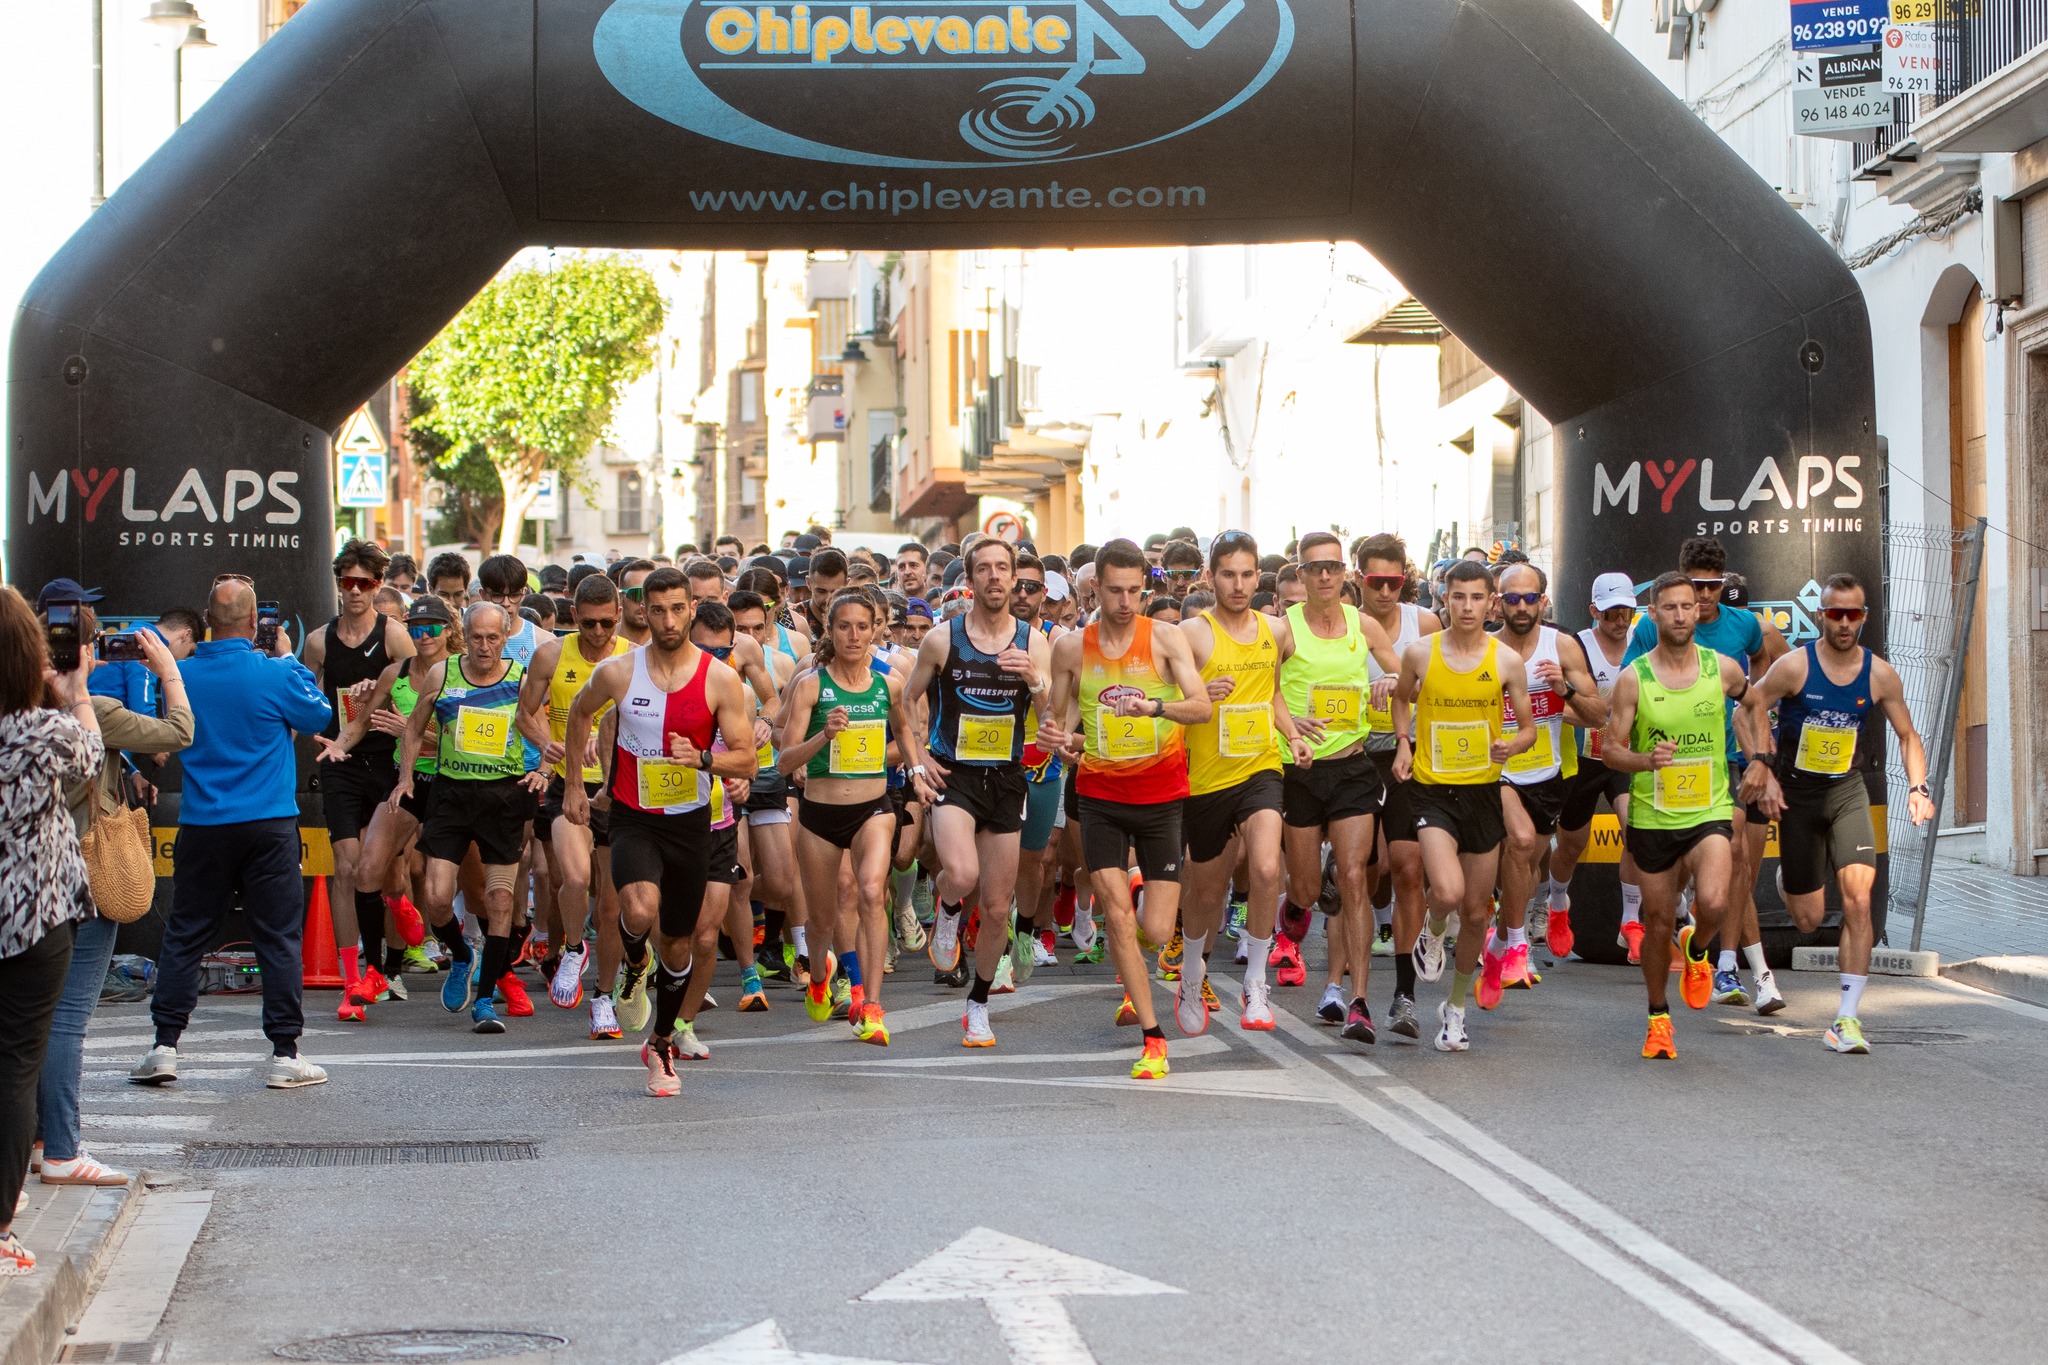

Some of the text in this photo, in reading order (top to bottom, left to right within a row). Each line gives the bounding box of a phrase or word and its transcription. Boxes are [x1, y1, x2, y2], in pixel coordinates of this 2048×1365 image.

[1822, 5, 1860, 17] VENDE
[1895, 4, 1911, 19] 96
[705, 4, 1071, 63] Chiplevante
[1793, 24, 1812, 41] 96
[1814, 21, 1845, 40] 238
[1846, 19, 1868, 36] 90
[1904, 30, 1927, 42] Rafa
[1824, 58, 1882, 75] ALBIÑAN
[1888, 76, 1903, 90] 96
[1908, 77, 1929, 90] 291
[1824, 86, 1866, 100] VENDE
[1801, 101, 1890, 122] 96 148 40 24
[688, 180, 1206, 216] www.chiplevante.com
[1592, 455, 1863, 516] MYLAPS
[27, 467, 301, 525] MYLAPS
[1696, 518, 1862, 536] SPORTS TIMING
[119, 532, 300, 549] SPORTS TIMING
[963, 687, 1018, 697] METAESPORT
[843, 703, 875, 713] acsa
[1325, 699, 1347, 714] 50
[1434, 698, 1441, 707] A.
[1443, 697, 1489, 708] KILÓMETRO
[475, 723, 495, 738] 48
[1123, 722, 1135, 738] 2
[1246, 720, 1255, 735] 7
[977, 730, 999, 744] 20
[1457, 737, 1469, 752] 9
[1671, 732, 1714, 746] VIDAL
[856, 737, 867, 753] 3
[1818, 740, 1840, 756] 36
[659, 771, 683, 788] 30
[1676, 774, 1697, 790] 27
[651, 787, 695, 798] VITALDENT
